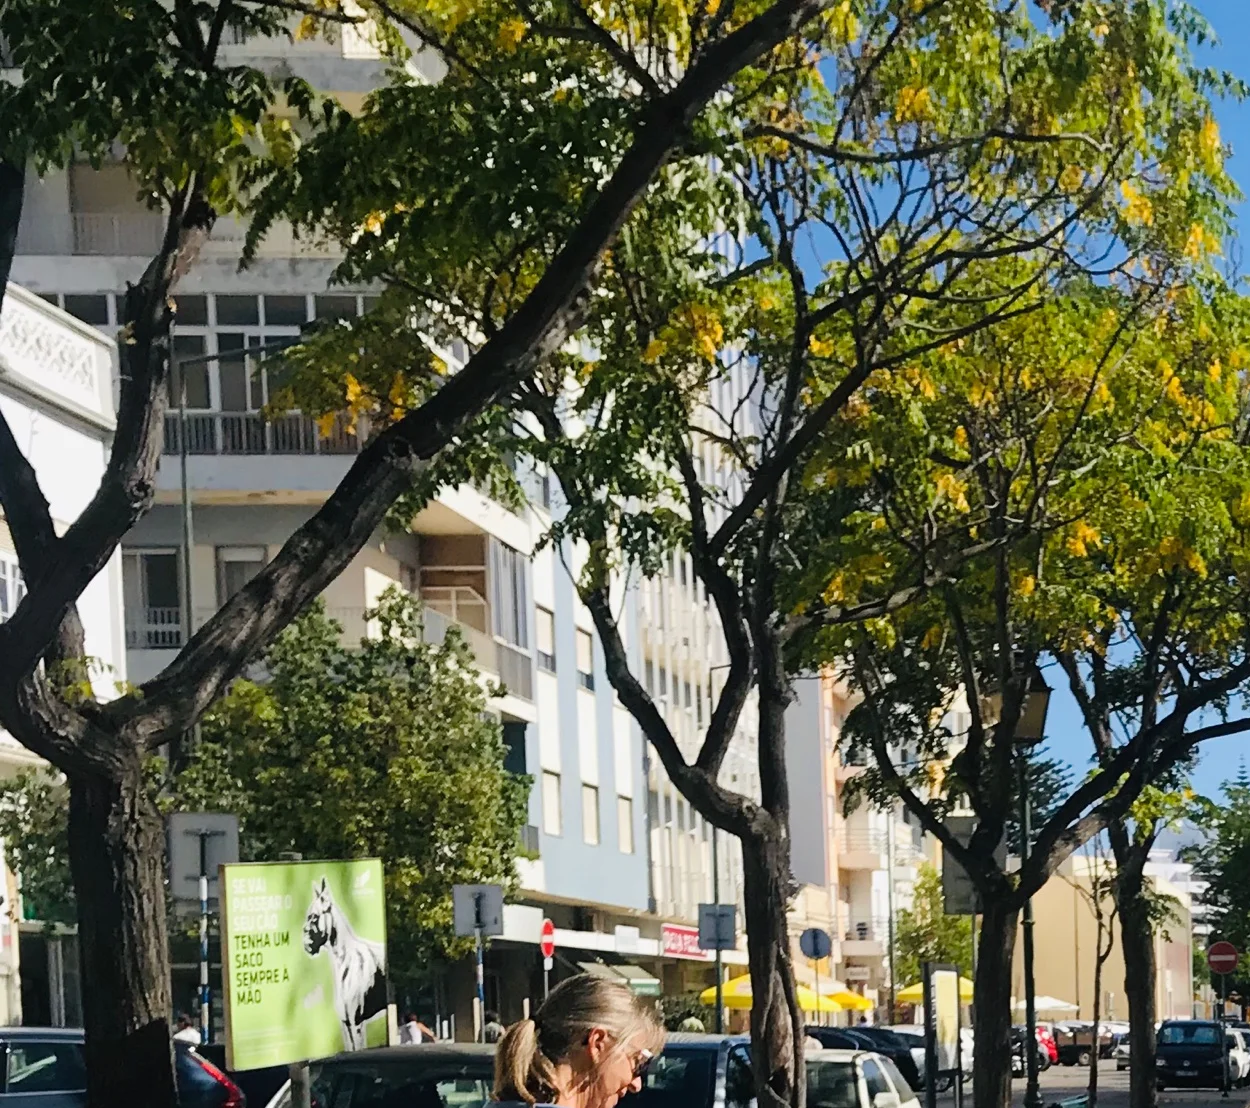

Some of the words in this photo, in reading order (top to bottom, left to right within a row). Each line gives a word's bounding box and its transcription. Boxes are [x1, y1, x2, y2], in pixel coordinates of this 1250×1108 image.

[234, 933, 271, 950] TENHA
[274, 931, 290, 947] UM
[235, 952, 264, 968] SACO
[236, 968, 279, 987] SEMPRE
